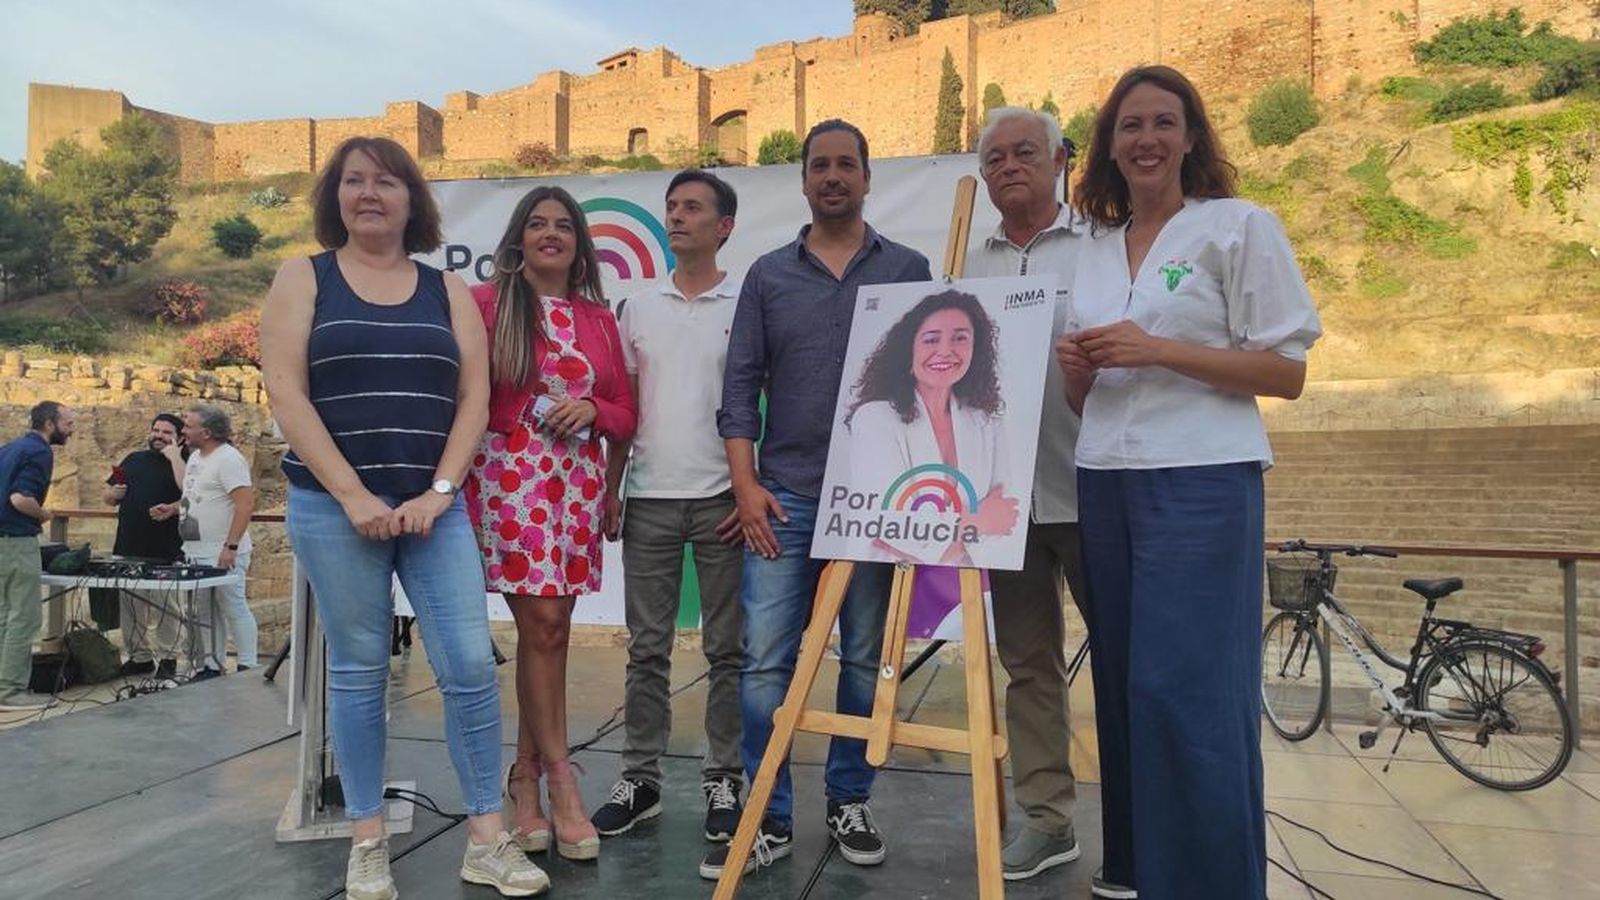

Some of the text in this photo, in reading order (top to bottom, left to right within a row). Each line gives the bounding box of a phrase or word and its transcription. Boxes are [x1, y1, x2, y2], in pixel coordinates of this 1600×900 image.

[446, 245, 495, 282] Po
[1009, 288, 1045, 305] INMA
[829, 485, 879, 510] Por
[824, 513, 979, 544] Andalucía
